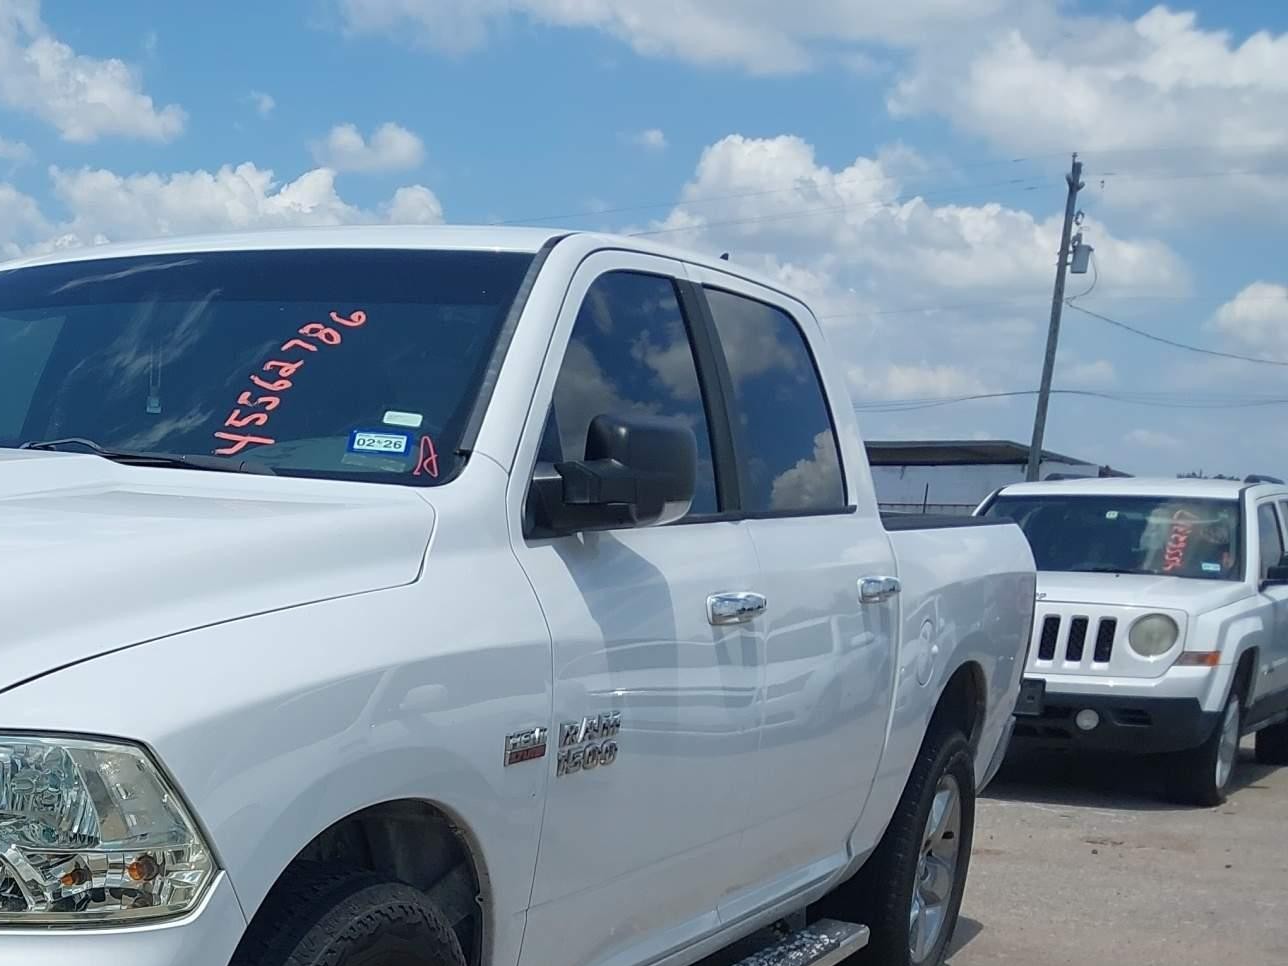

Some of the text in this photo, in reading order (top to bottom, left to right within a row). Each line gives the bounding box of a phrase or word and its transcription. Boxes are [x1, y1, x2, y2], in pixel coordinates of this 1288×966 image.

[213, 310, 367, 456] 45562786
[356, 437, 403, 450] 02 26
[558, 710, 621, 749] RAM
[556, 737, 619, 777] 1500
